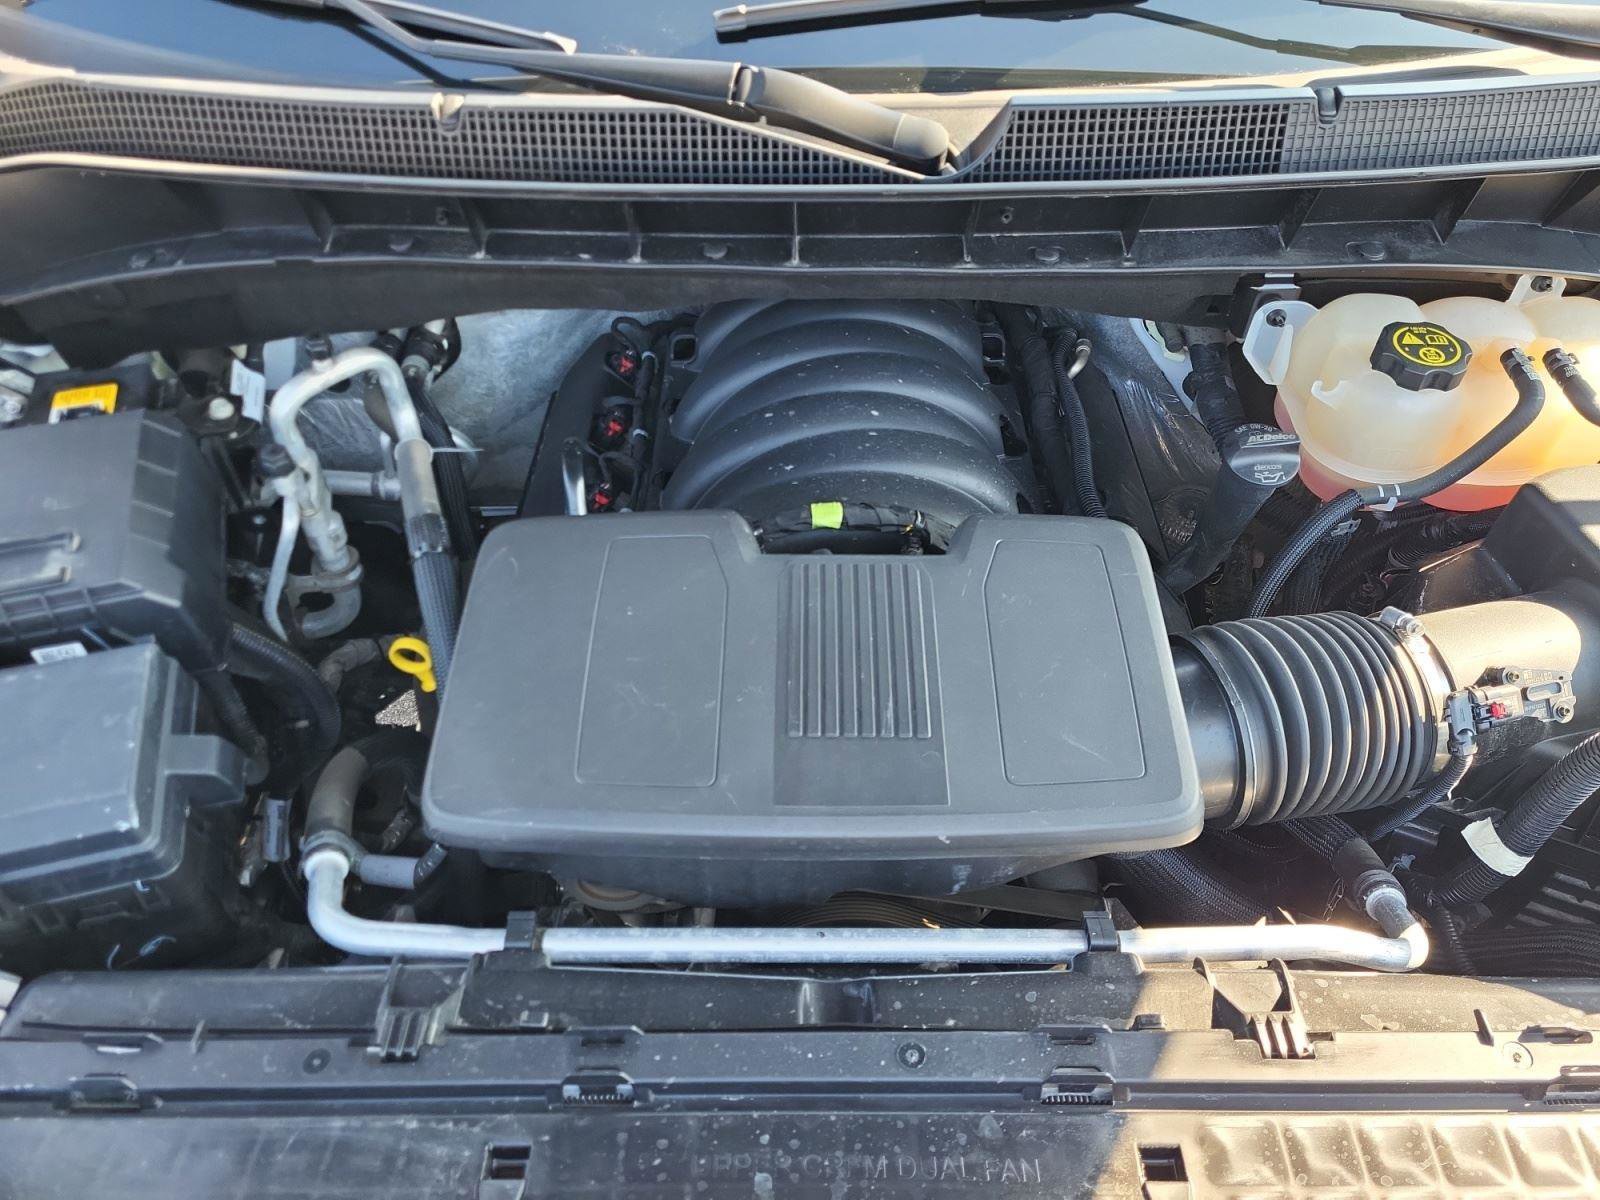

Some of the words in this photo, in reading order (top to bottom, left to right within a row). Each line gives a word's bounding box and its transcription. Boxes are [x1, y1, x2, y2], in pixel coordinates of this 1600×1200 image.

[1234, 425, 1248, 434] SAE
[1250, 423, 1272, 432] 0W-20
[1247, 433, 1296, 442] ACDelco
[898, 1155, 971, 1179] DUAL
[984, 1157, 1041, 1184] FAN
